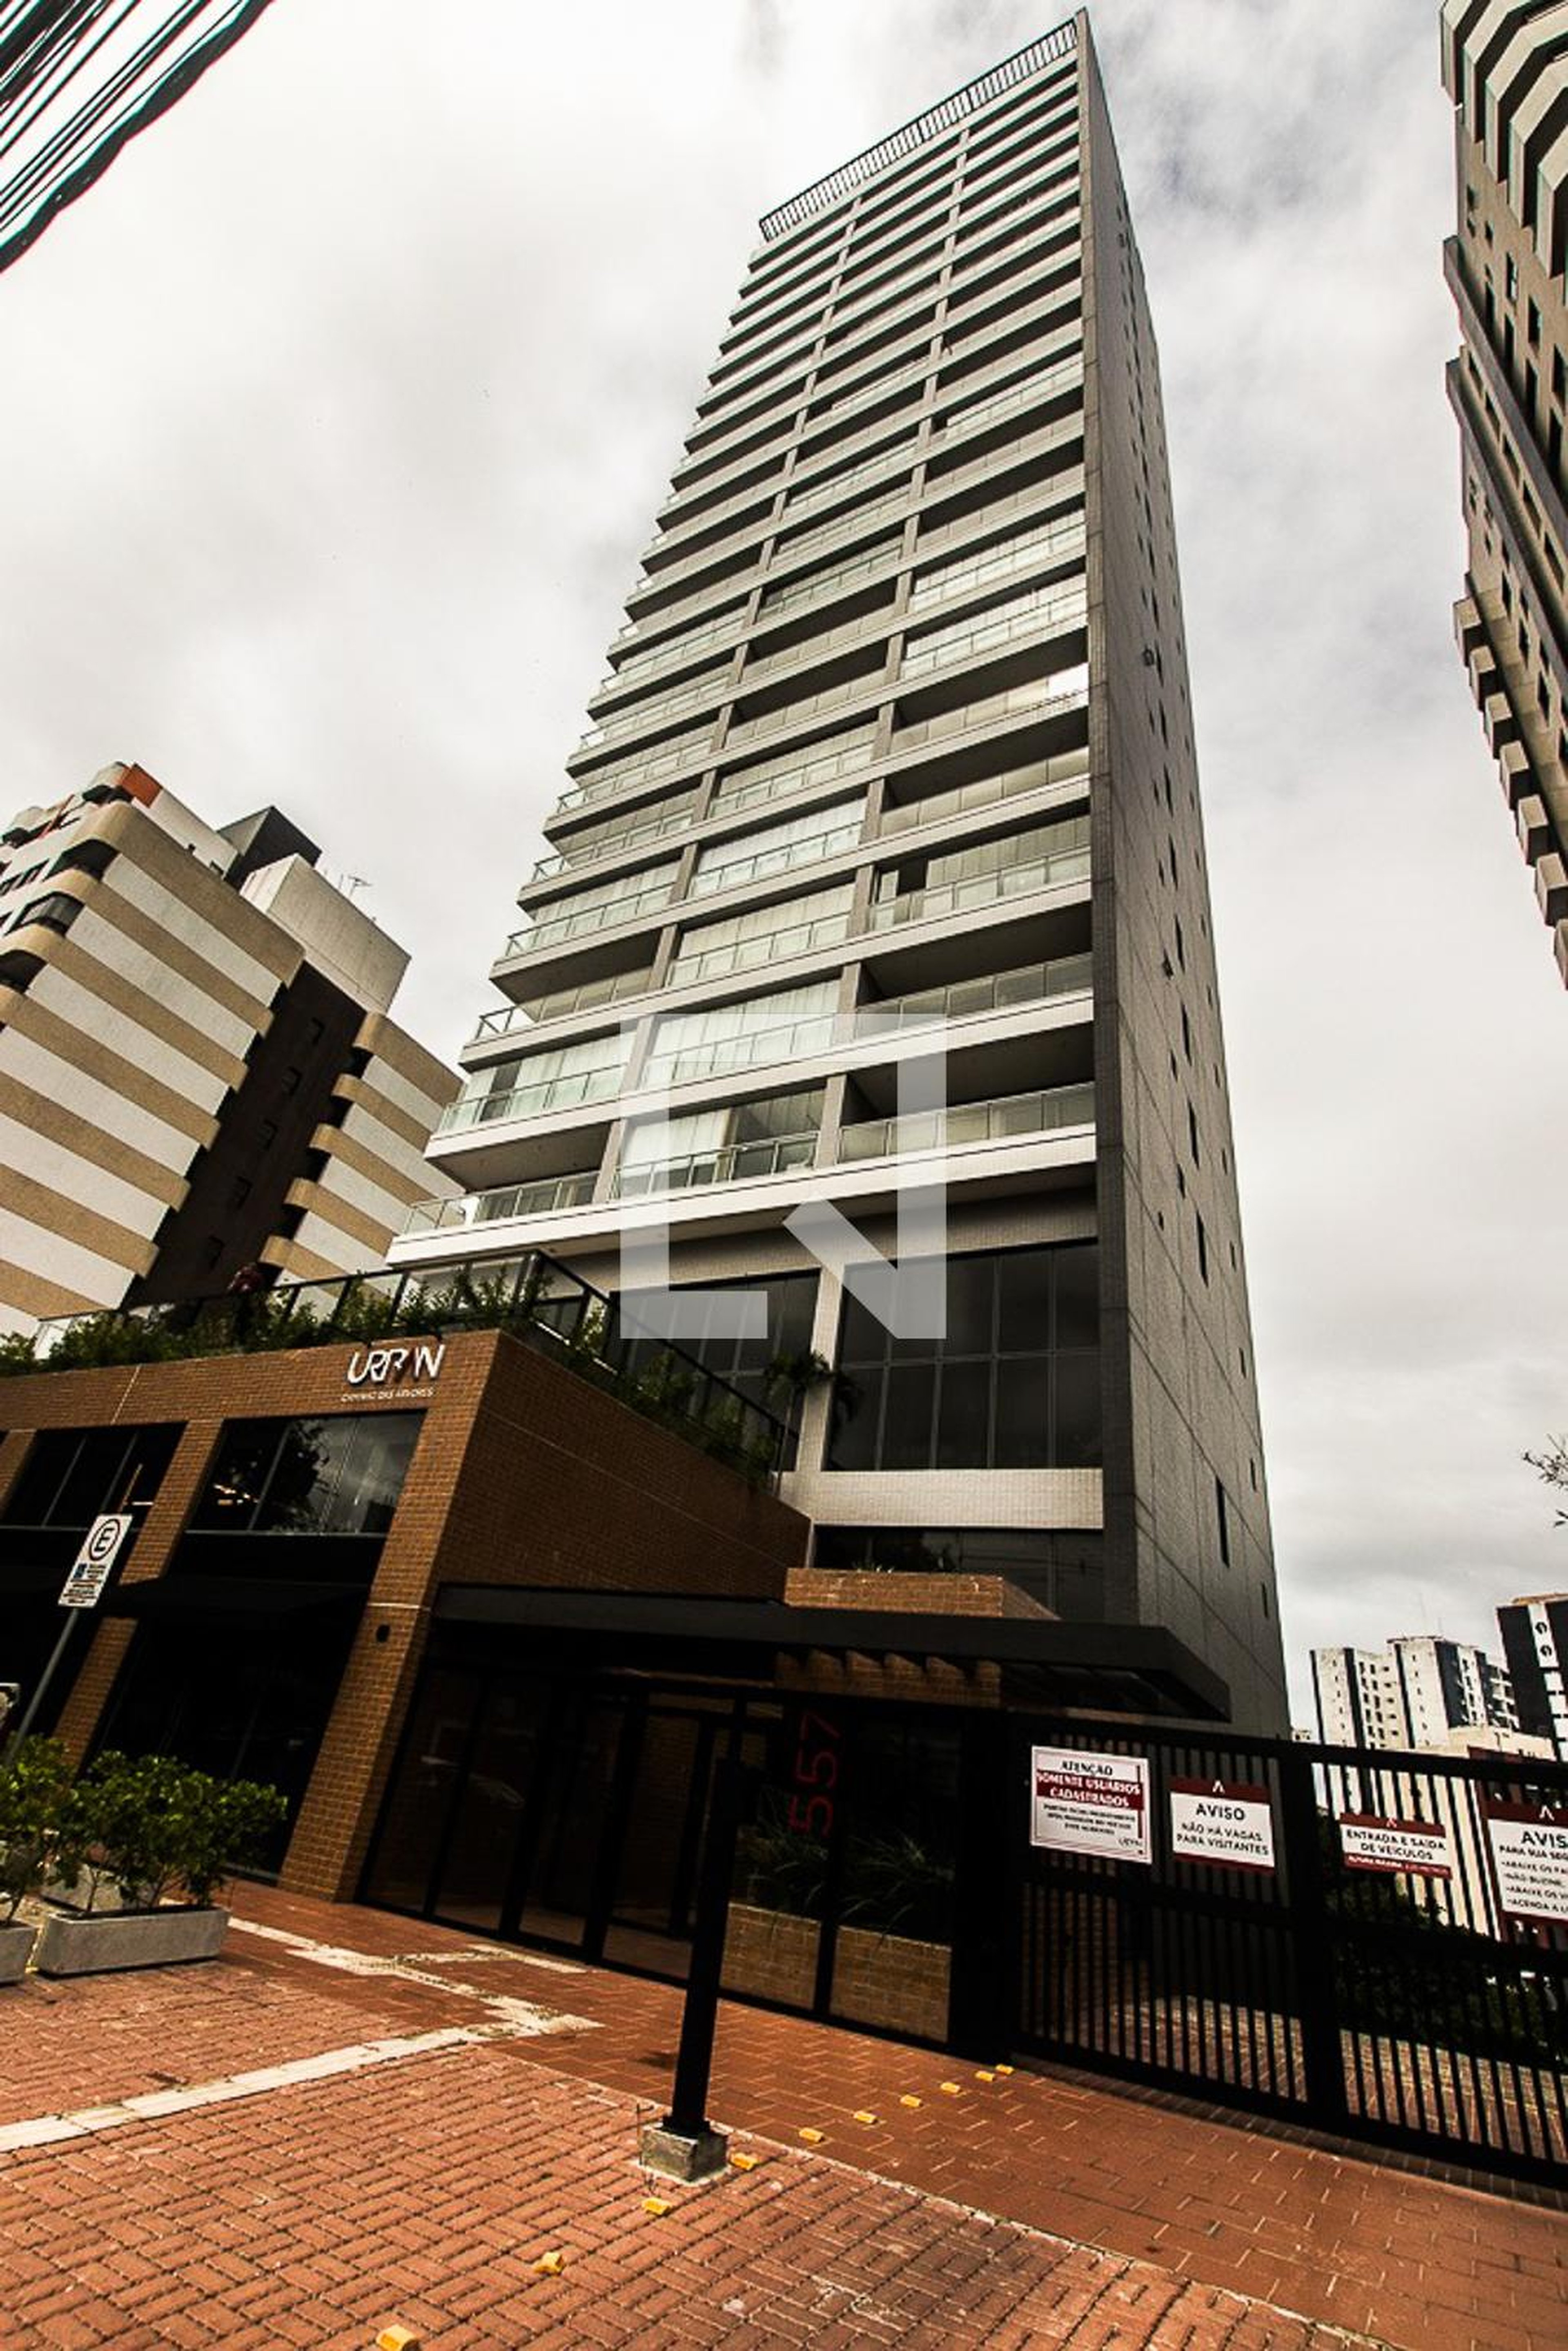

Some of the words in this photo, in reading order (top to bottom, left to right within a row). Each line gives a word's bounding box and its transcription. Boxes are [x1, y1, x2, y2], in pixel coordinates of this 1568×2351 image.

[787, 1711, 842, 1838] 557
[1050, 1787, 1129, 1807] CADASTRADOS
[1196, 1803, 1245, 1821] AVISO
[1225, 1828, 1263, 1842] VAGAS
[1347, 1829, 1398, 1843] ENTRADA
[1401, 1836, 1408, 1846] E
[1521, 1831, 1568, 1849] AVIS
[1177, 1833, 1204, 1845] PARA
[1207, 1838, 1269, 1856] VISITANTES
[1361, 1843, 1376, 1853] DE
[1499, 1845, 1525, 1856] PARA
